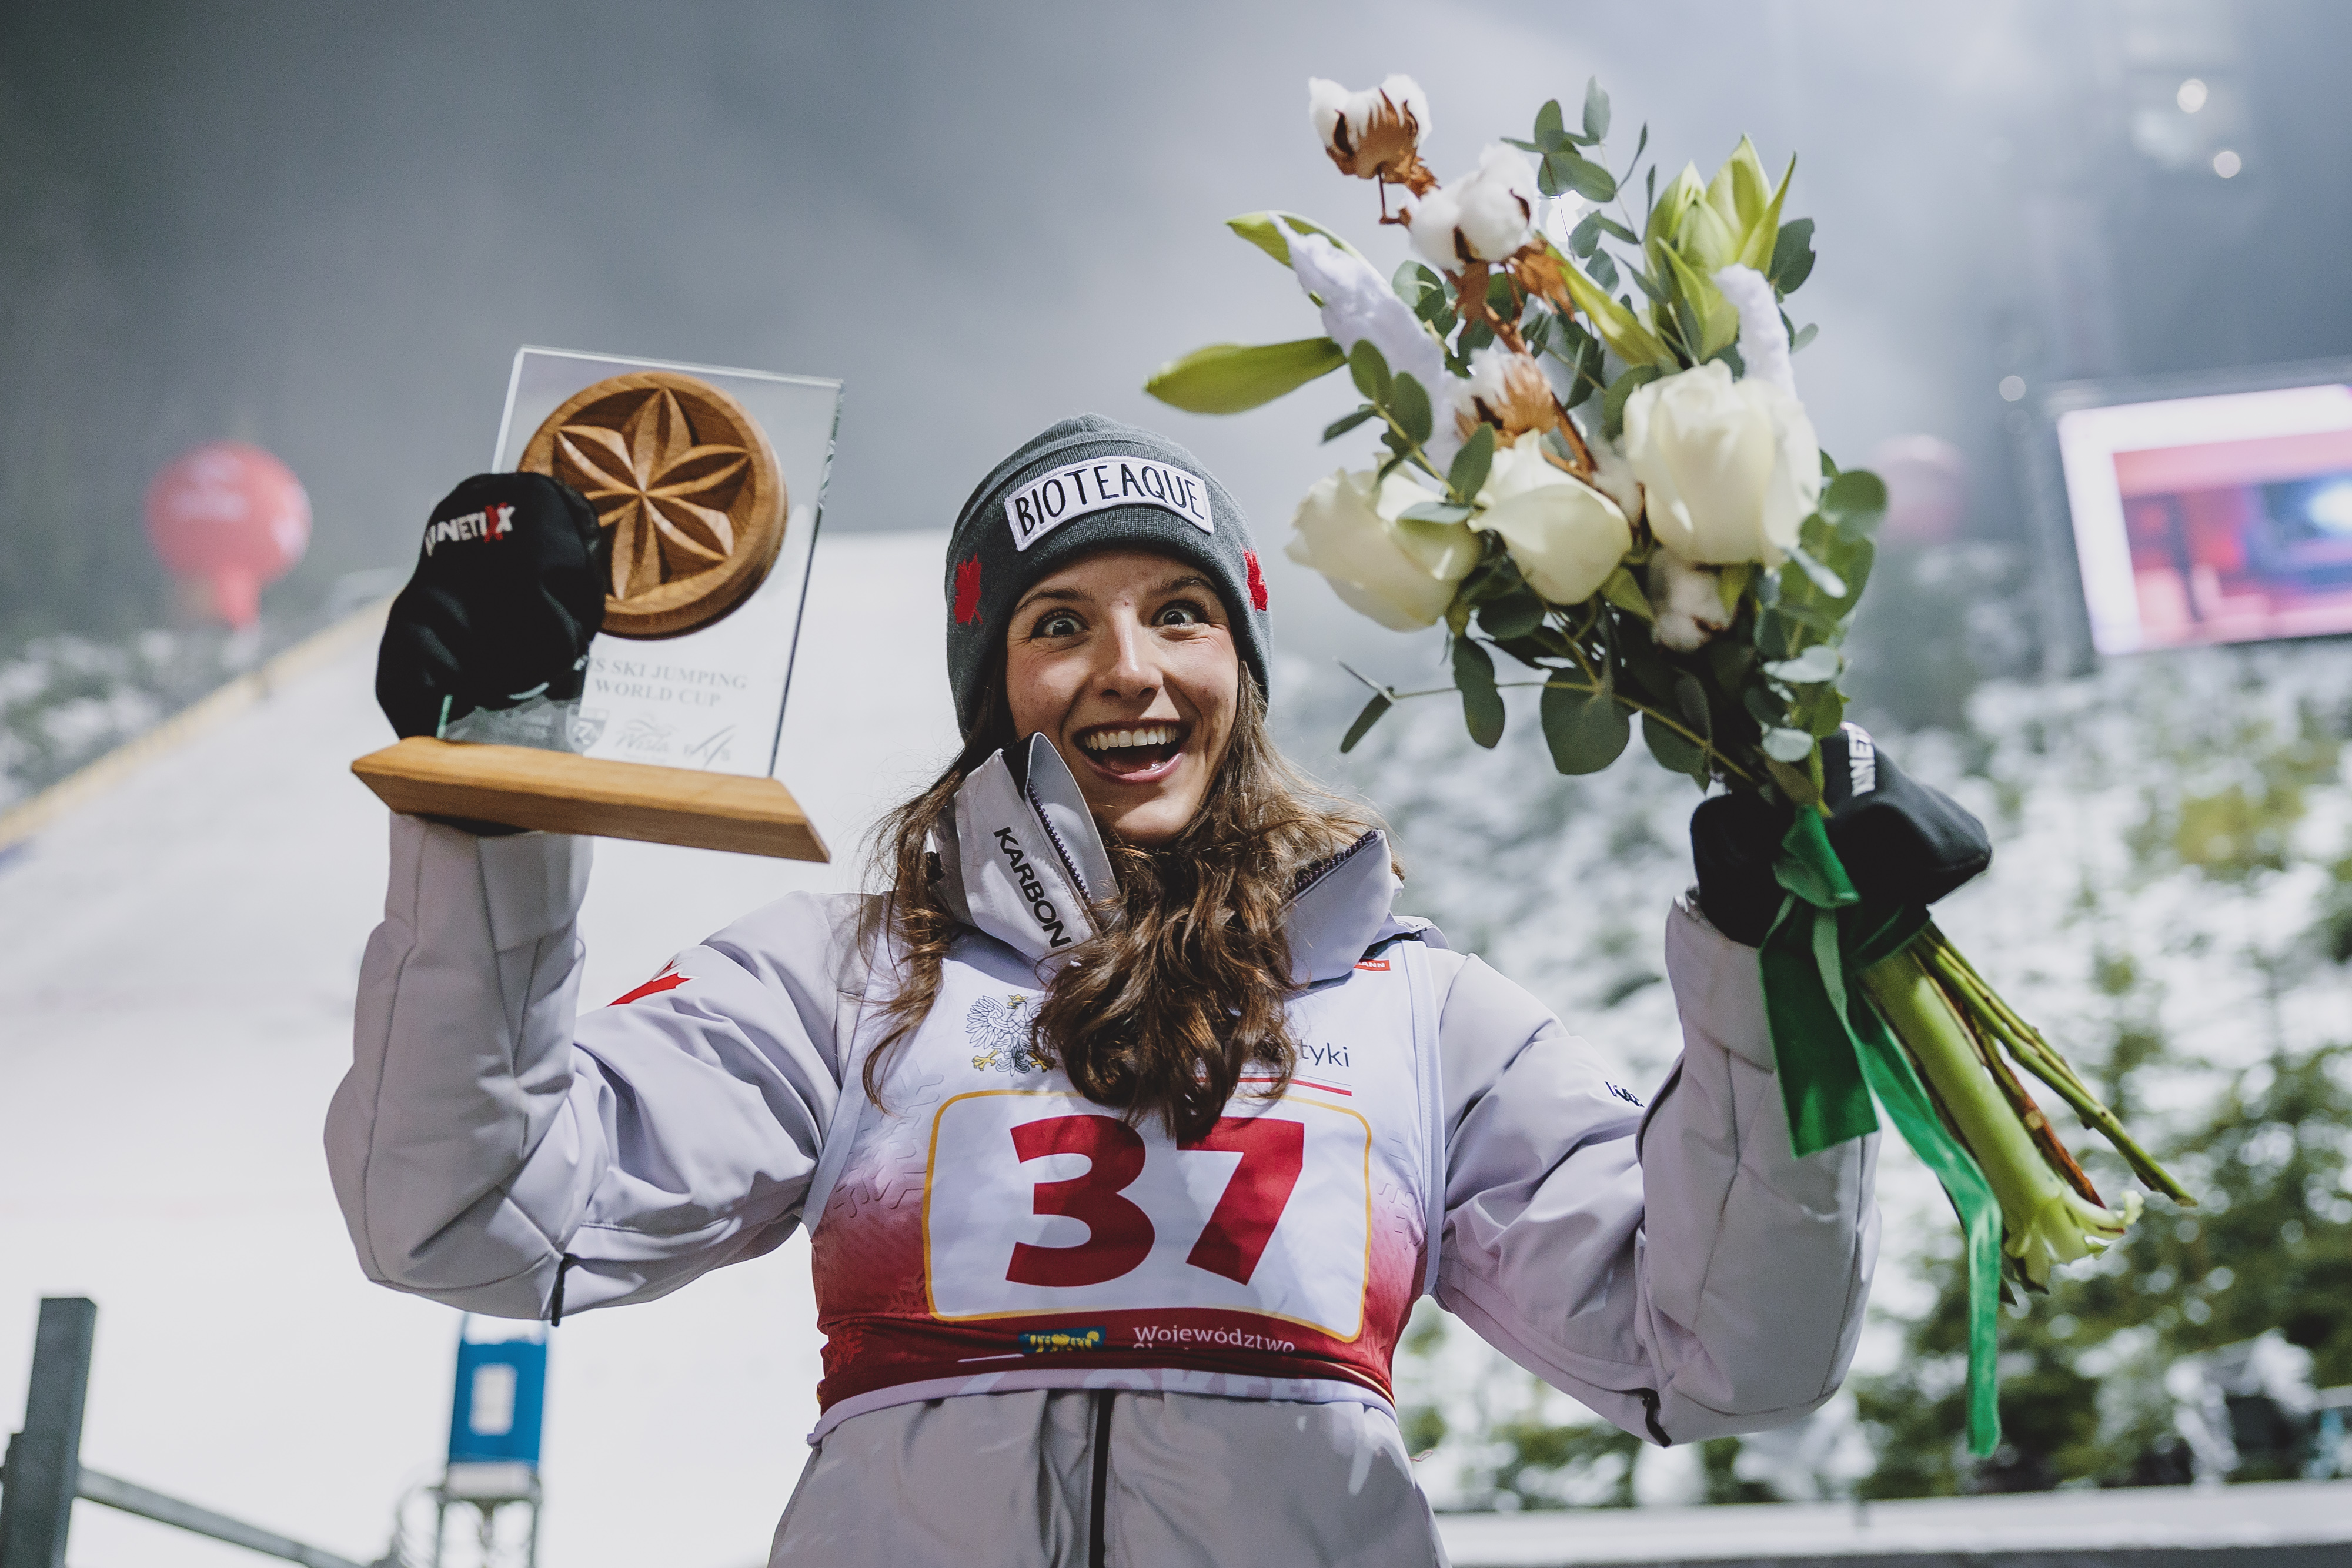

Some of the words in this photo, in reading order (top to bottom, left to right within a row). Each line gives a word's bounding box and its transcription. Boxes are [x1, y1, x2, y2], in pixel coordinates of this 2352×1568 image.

[1015, 463, 1204, 536] BIOTEAQUE
[612, 659, 646, 677] SKI
[651, 664, 749, 690] JUMPING
[594, 678, 673, 701] WORLD
[679, 688, 722, 707] CUP
[993, 827, 1073, 948] KARBON
[1299, 1039, 1350, 1067] tyki
[1005, 1115, 1304, 1288] 37
[1132, 1325, 1295, 1352] Województwo
